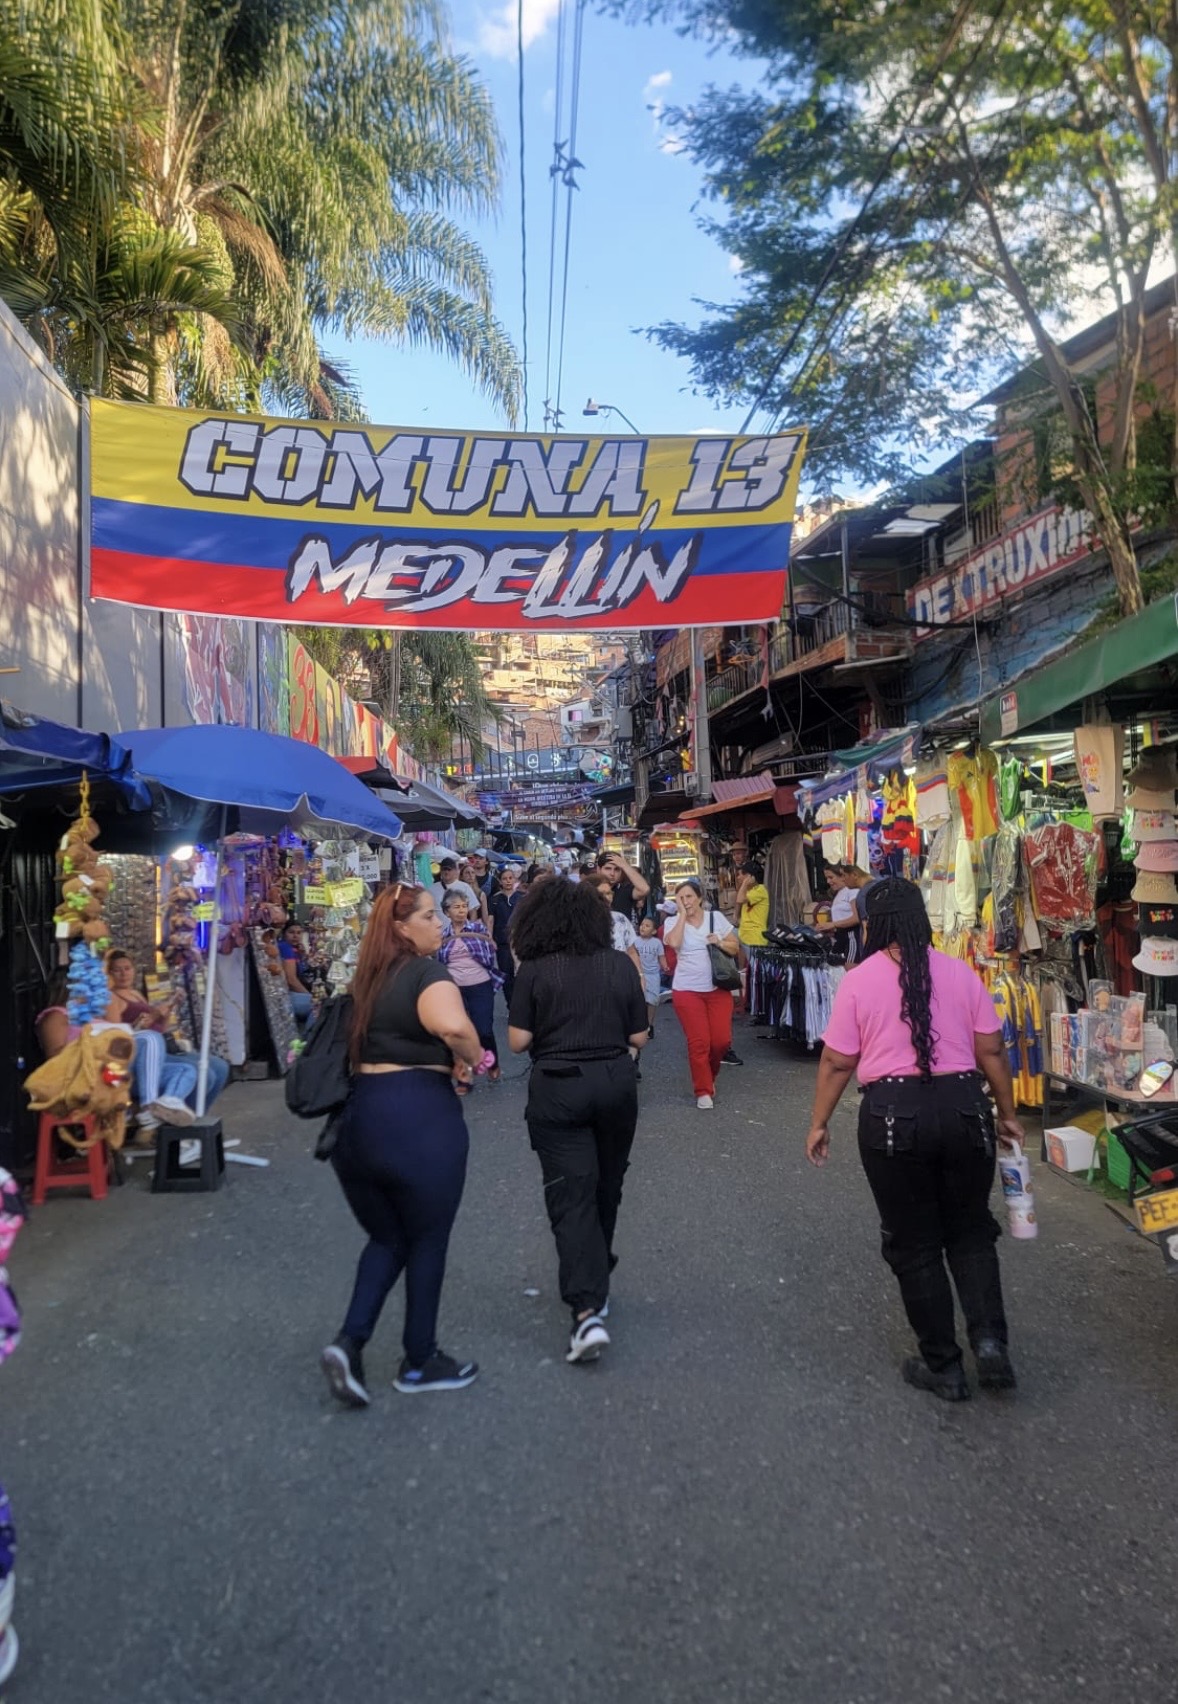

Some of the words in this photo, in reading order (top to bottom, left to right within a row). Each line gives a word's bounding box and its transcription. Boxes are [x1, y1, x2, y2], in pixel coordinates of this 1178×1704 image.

[178, 417, 648, 517] COMUNA
[672, 433, 804, 516] 13
[286, 500, 704, 618] MEDELLÍN
